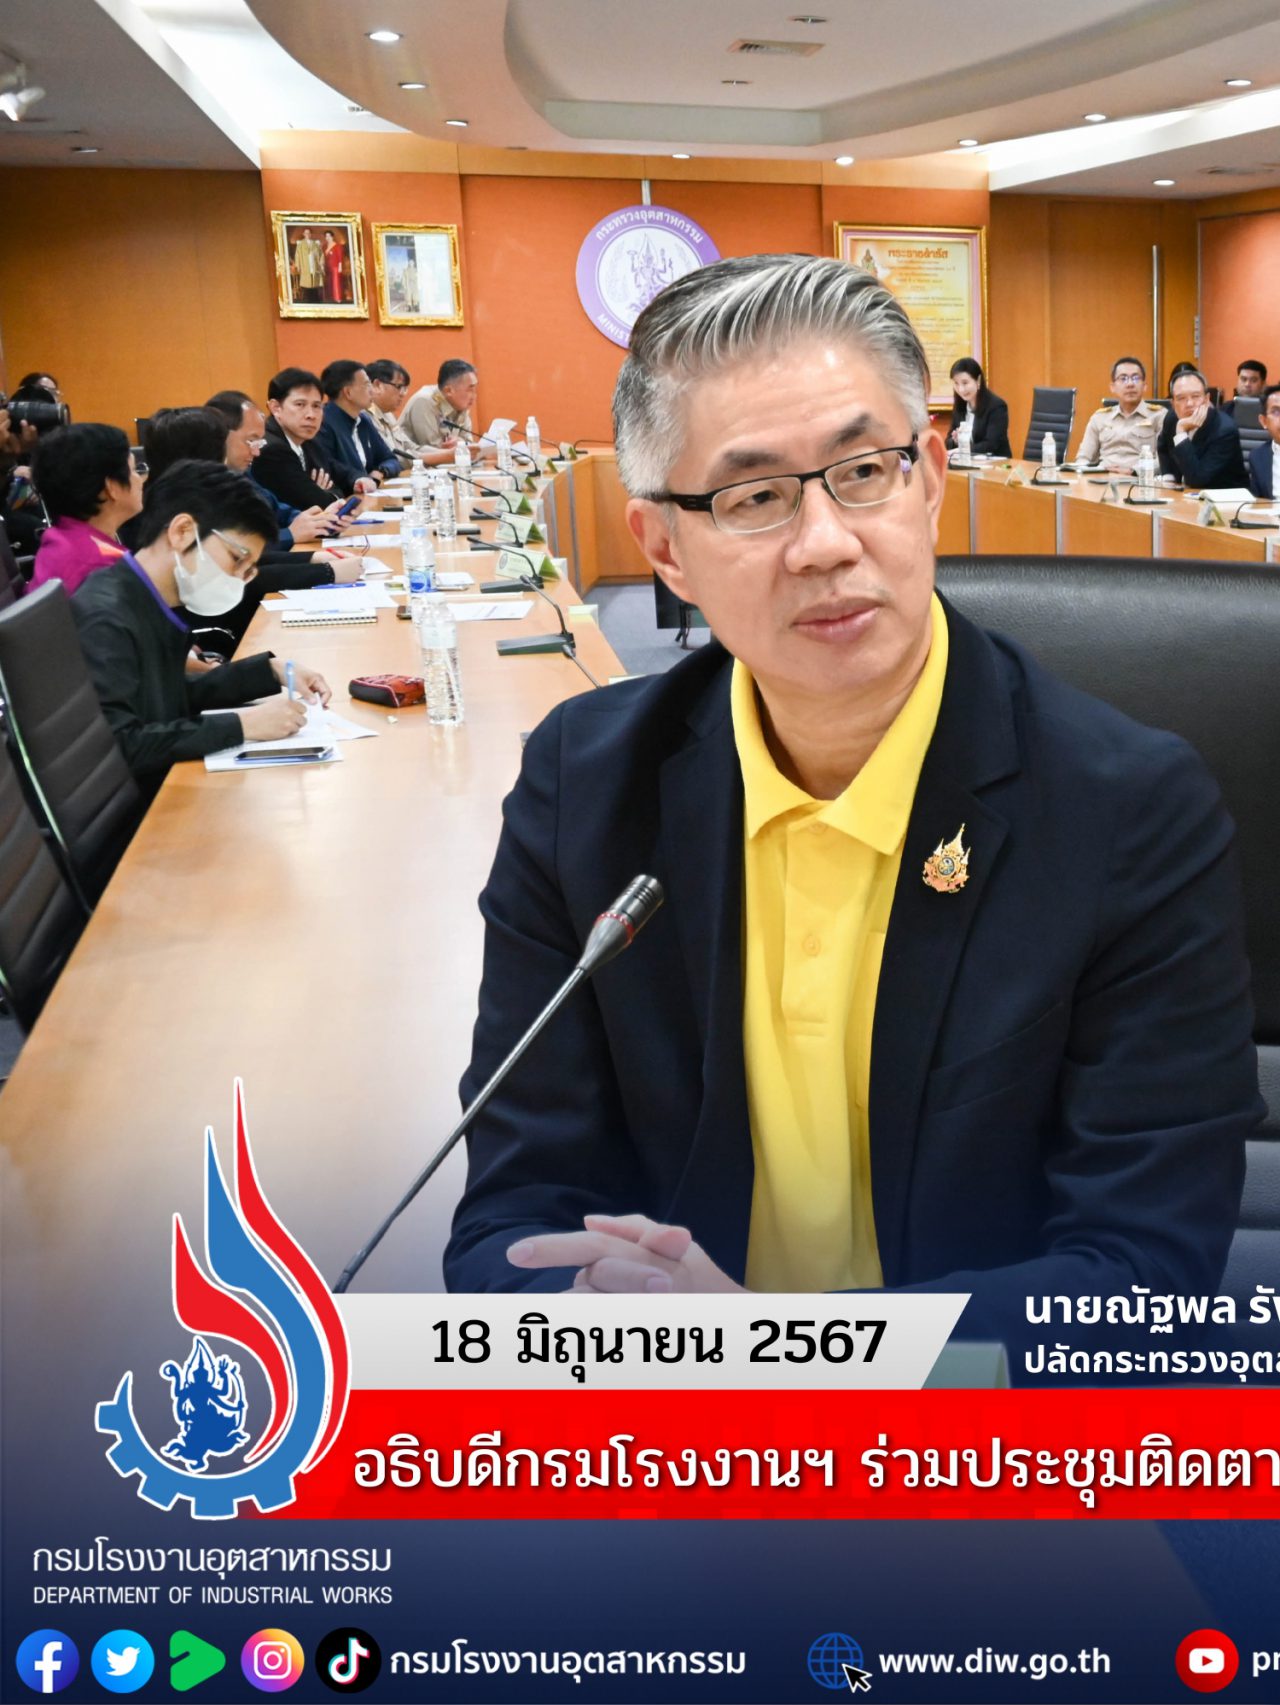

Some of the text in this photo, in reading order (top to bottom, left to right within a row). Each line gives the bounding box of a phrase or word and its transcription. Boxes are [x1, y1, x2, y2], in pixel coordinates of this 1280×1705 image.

[595, 209, 704, 245] กระทรวงอุตสาหกรรม
[597, 312, 631, 344] MINIST
